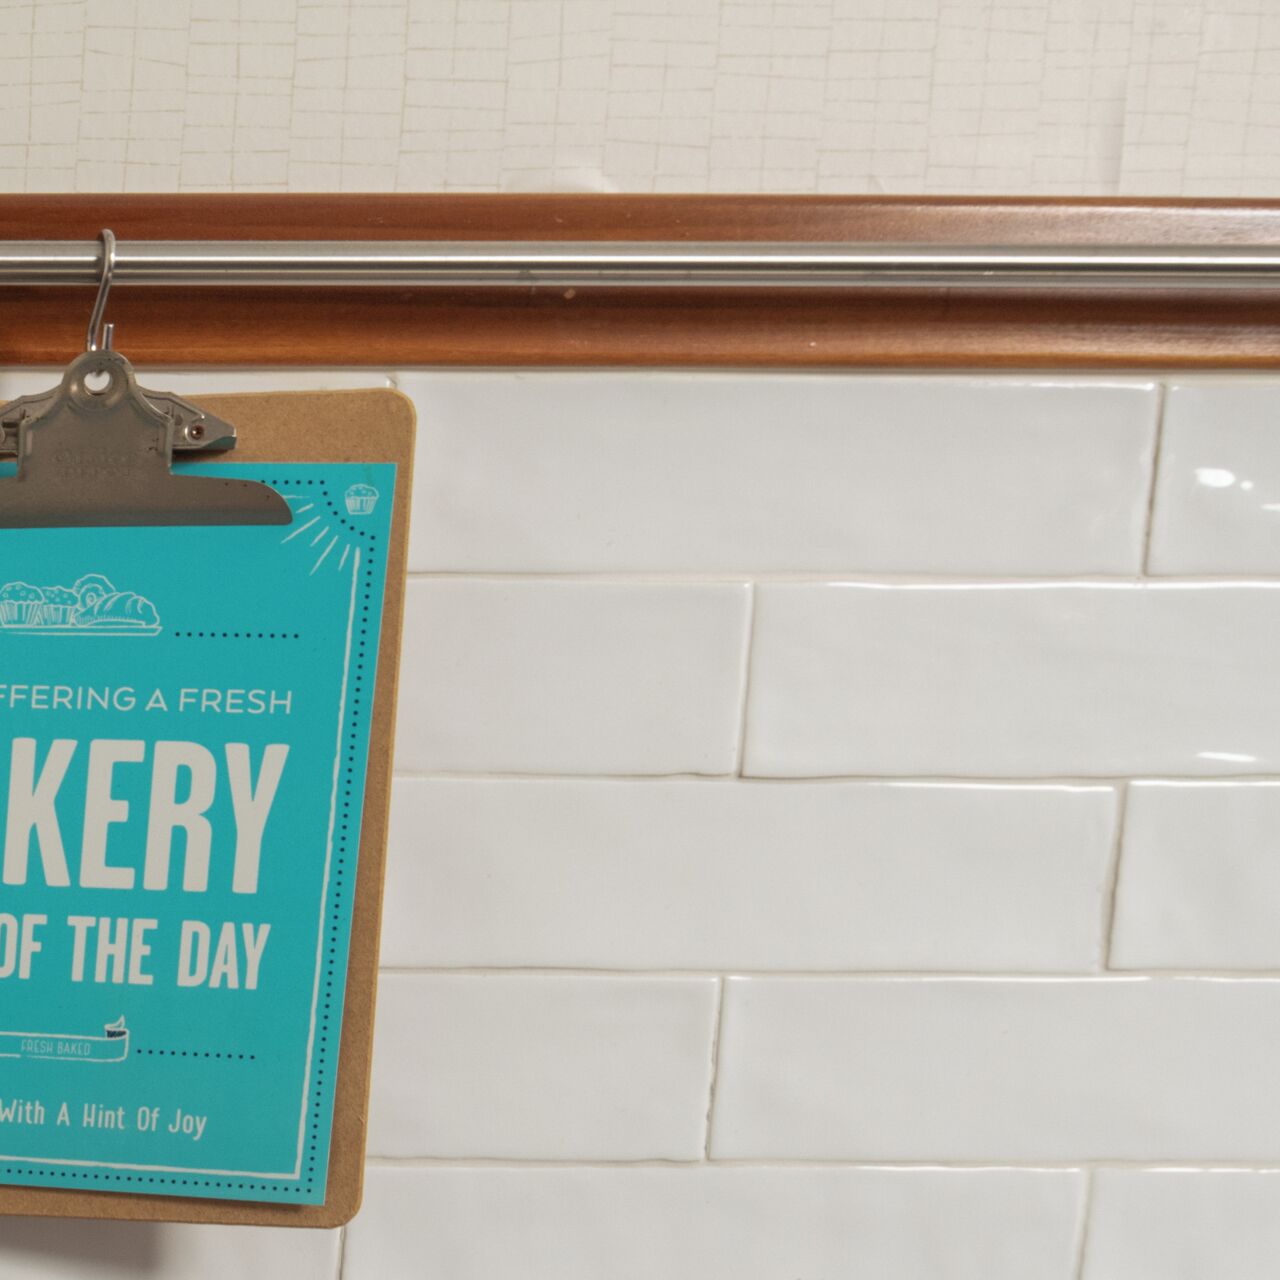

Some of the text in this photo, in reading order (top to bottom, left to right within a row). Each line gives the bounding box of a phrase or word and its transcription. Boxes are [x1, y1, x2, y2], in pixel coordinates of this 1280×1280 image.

[146, 689, 168, 711] A
[179, 688, 292, 714] FRESH
[67, 915, 158, 985] THE
[176, 920, 271, 990] DAY
[20, 1038, 91, 1056] FRESH BAKED
[57, 1102, 70, 1126] A
[83, 1103, 125, 1129] Hint
[137, 1106, 159, 1131] Of
[168, 1109, 207, 1140] Joy
